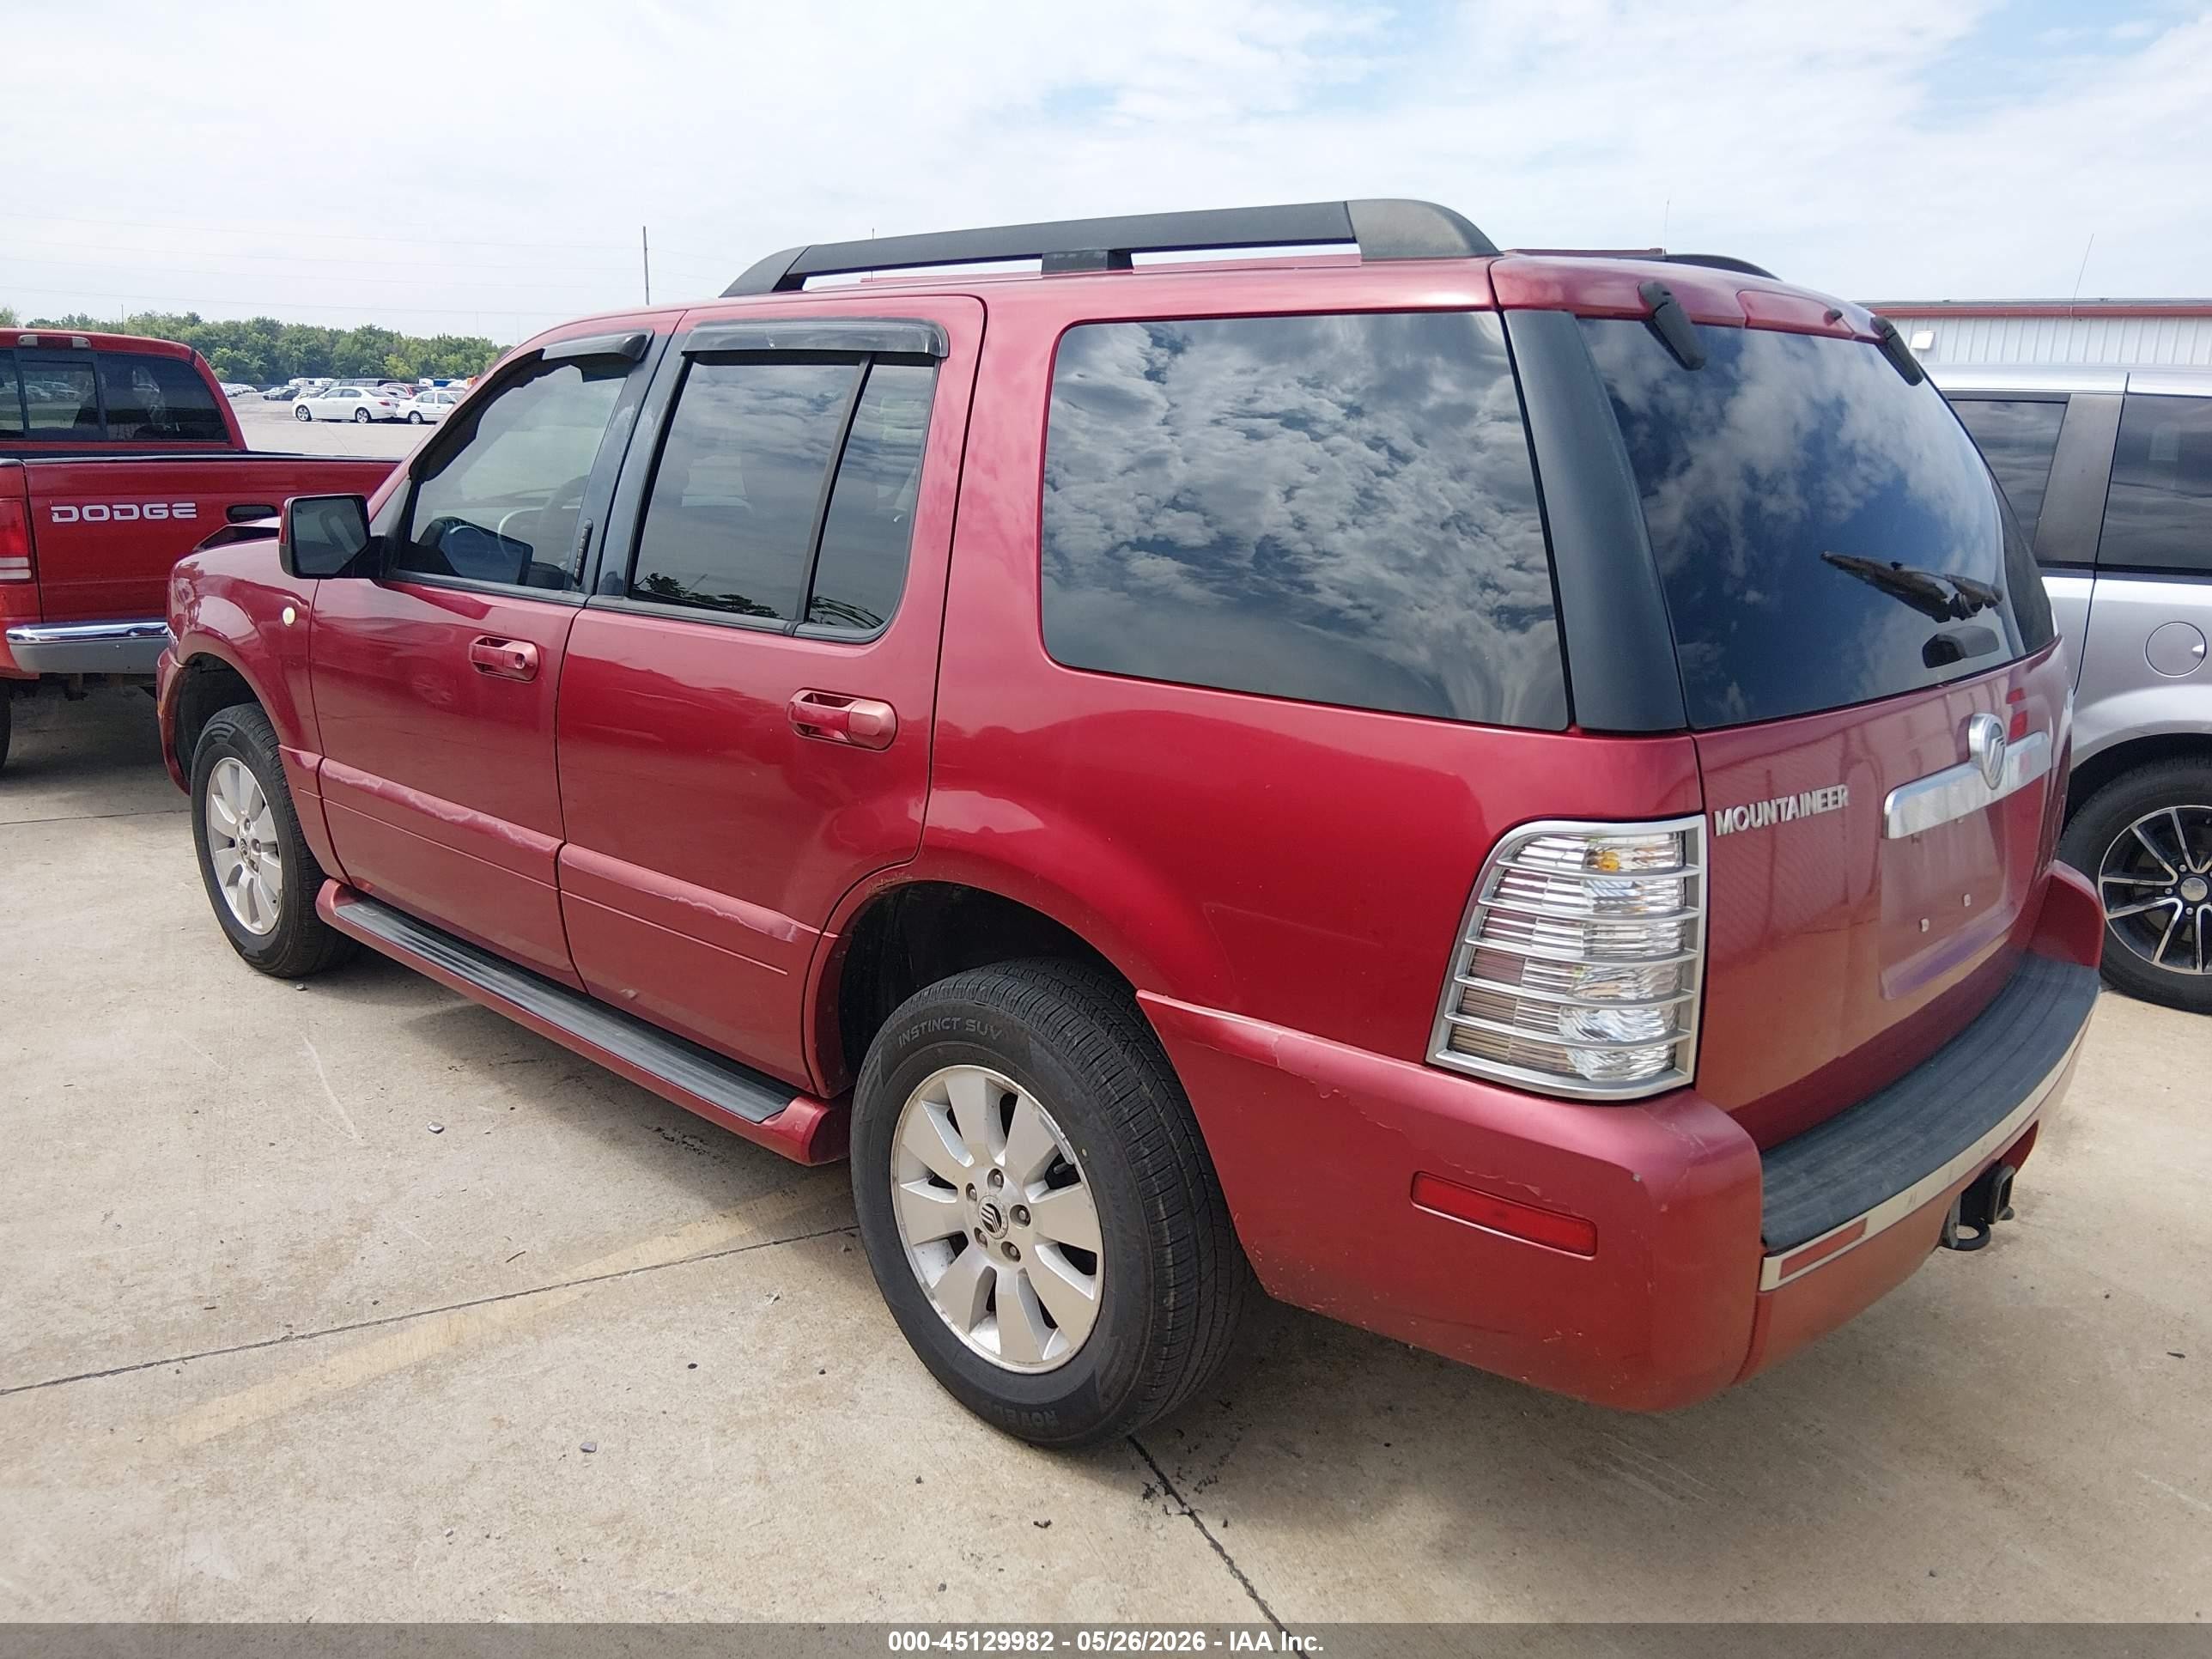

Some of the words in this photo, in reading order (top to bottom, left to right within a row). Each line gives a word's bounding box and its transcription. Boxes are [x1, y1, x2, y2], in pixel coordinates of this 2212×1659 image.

[51, 502, 198, 523] DODGE
[1714, 783, 1849, 836] MOUNTAINEER
[898, 1017, 961, 1048] INSTINCT
[965, 1018, 1003, 1040] SUV
